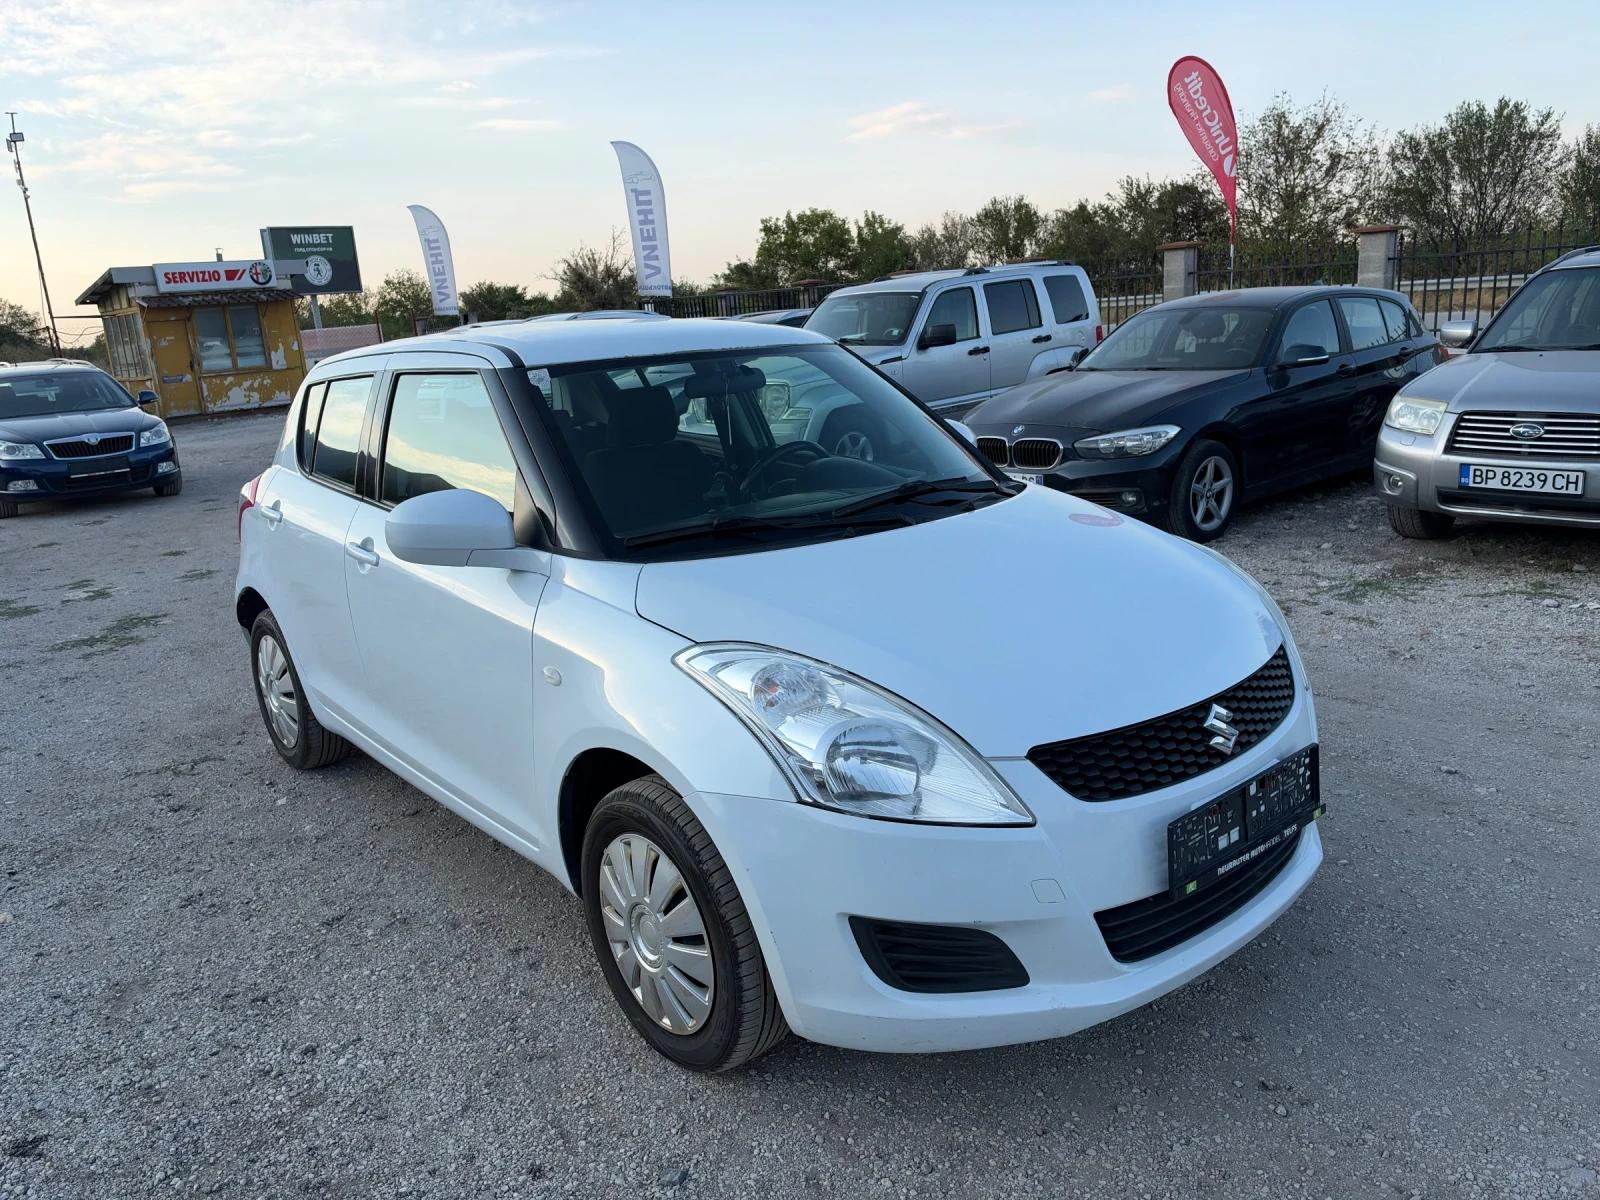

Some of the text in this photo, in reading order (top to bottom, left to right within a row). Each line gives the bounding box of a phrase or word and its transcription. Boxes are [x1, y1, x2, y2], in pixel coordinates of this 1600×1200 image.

[290, 233, 334, 245] WINBET
[163, 270, 221, 285] SERVIZIO
[1500, 470, 1548, 490] 8239
[1552, 473, 1580, 492] CH
[1283, 823, 1298, 838] TELFS
